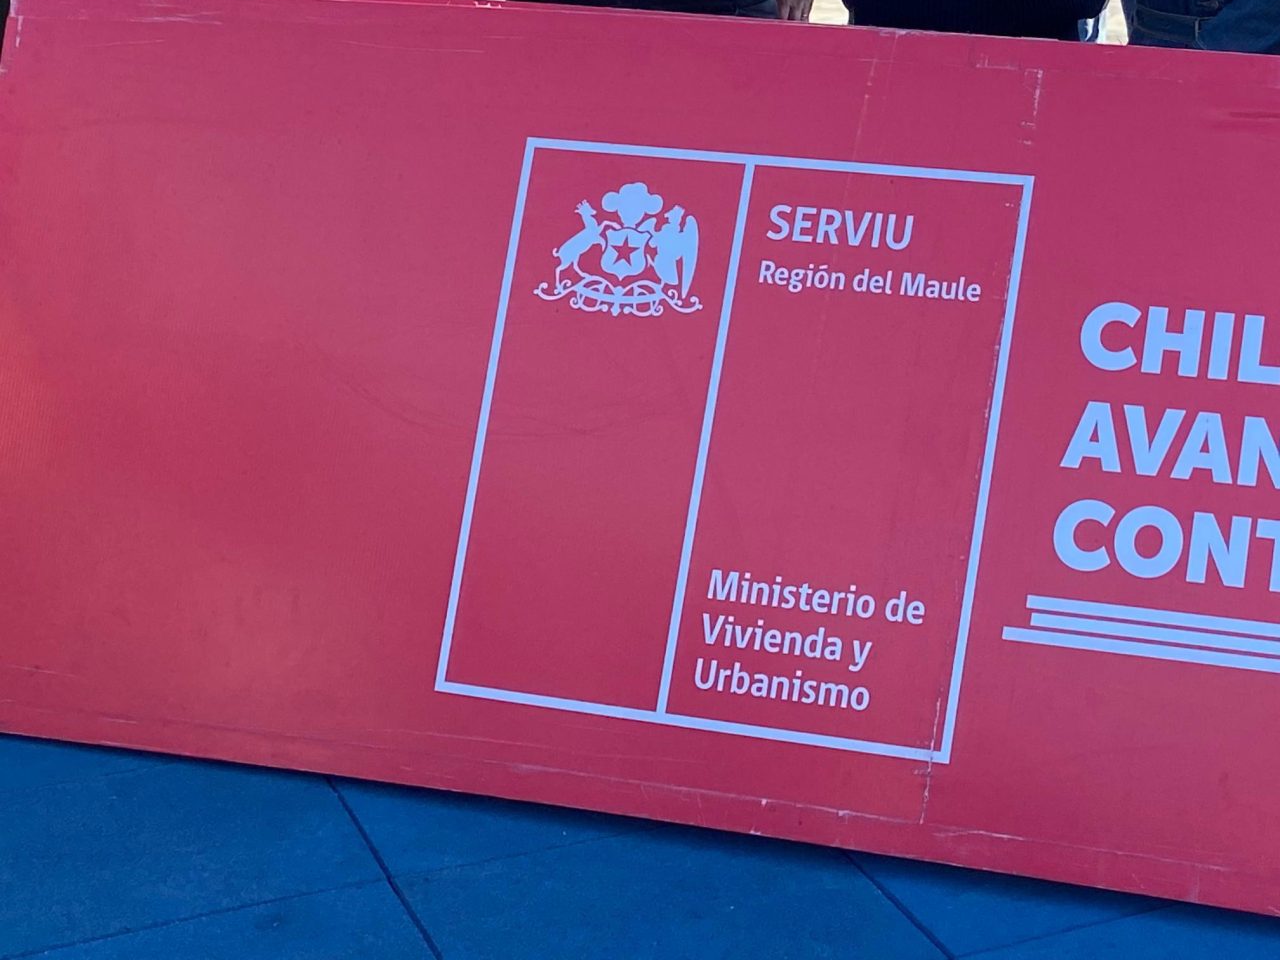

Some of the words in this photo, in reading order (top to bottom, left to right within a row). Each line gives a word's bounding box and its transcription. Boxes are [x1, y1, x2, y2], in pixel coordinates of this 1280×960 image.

[766, 204, 914, 250] SERVIU
[758, 260, 846, 293] Región
[852, 268, 893, 295] del
[899, 272, 981, 302] Maule
[707, 569, 876, 619] Ministerio
[885, 590, 925, 625] de
[702, 613, 843, 661] Vivienda
[848, 639, 873, 672] y
[694, 657, 870, 711] Urbanismo
